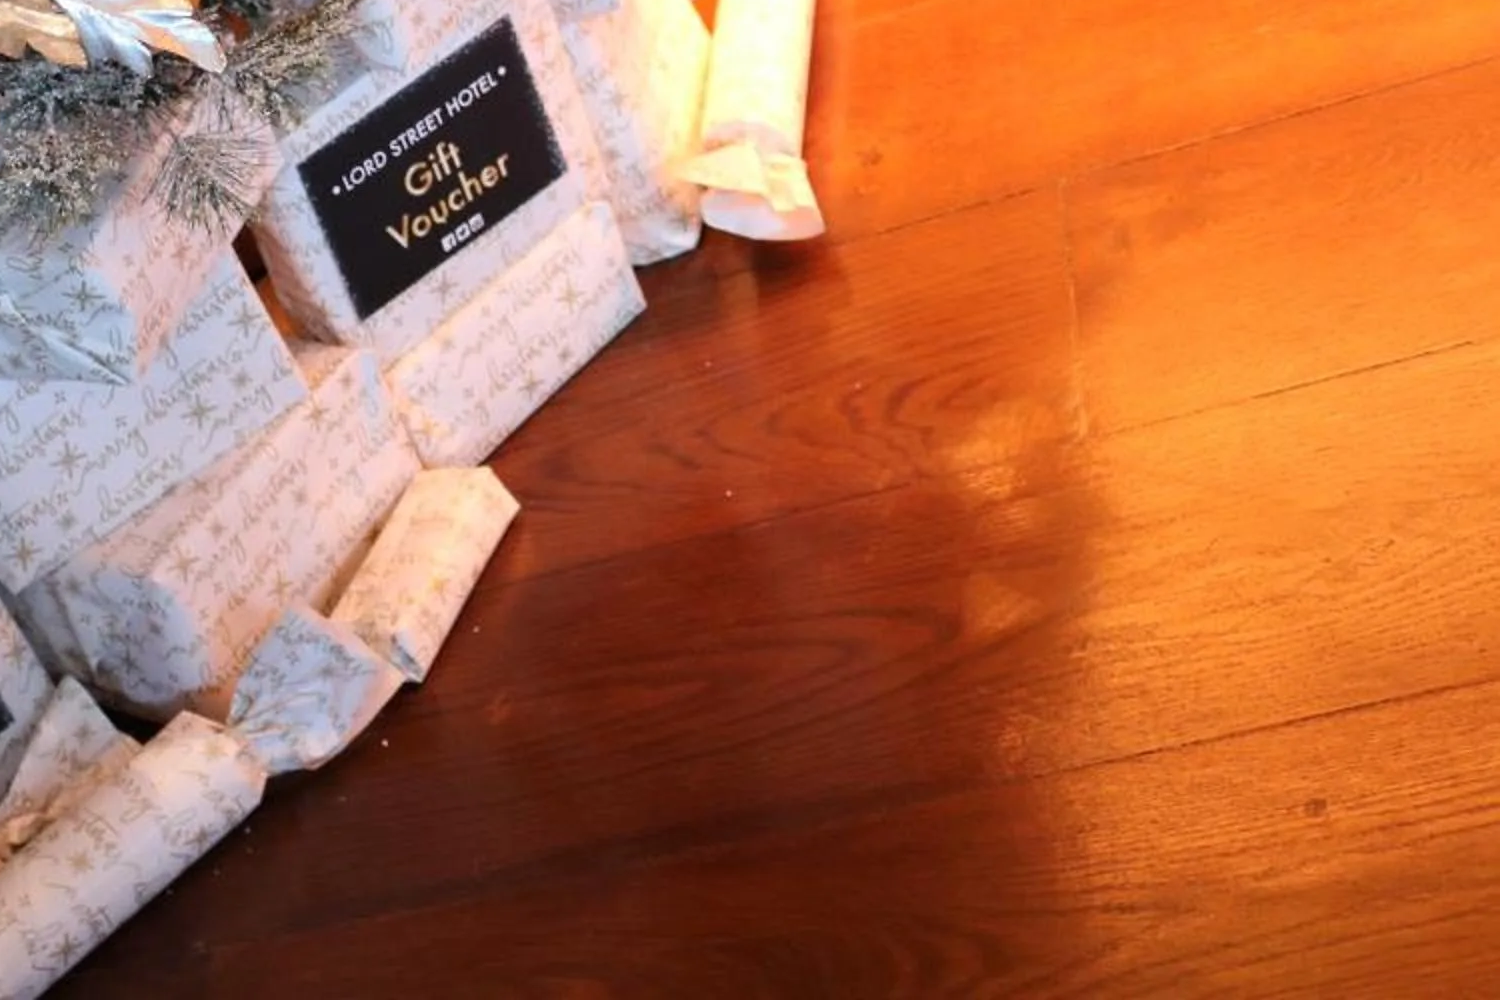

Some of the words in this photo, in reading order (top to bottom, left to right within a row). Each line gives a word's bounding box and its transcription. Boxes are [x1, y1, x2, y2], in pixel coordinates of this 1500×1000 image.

[341, 150, 387, 191] LORD
[389, 109, 445, 158] STREET
[446, 71, 498, 119] HOTEL
[404, 141, 463, 196] Gift
[385, 153, 510, 248] Voucher
